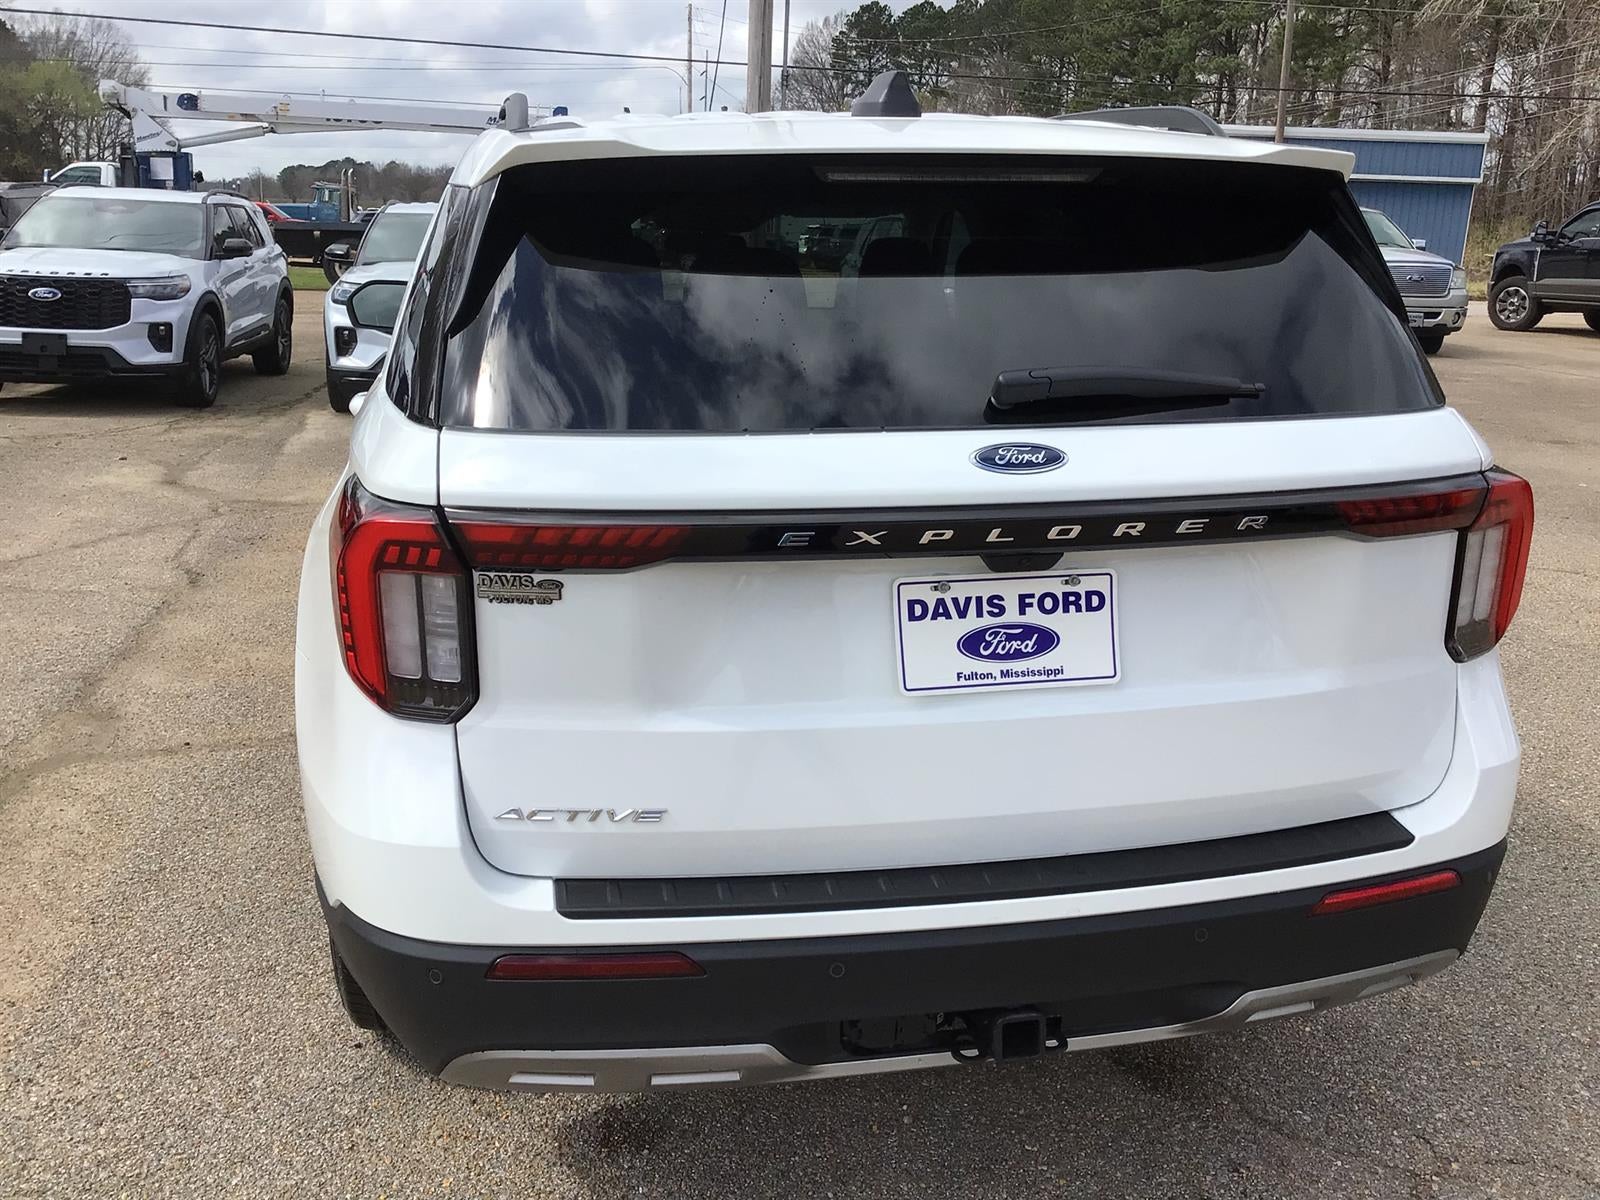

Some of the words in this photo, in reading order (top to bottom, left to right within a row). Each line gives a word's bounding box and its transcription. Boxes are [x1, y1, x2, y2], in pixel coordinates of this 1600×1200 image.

[994, 446, 1047, 465] Ford
[777, 515, 1269, 547] EXPLORER
[478, 574, 534, 590] DAVIS
[906, 594, 1007, 622] DAVIS
[1017, 589, 1107, 616] FORD
[979, 628, 1039, 656] Ford
[956, 668, 997, 682] Fulton,
[999, 665, 1065, 679] Mississippi
[494, 807, 668, 822] ACTIVE
